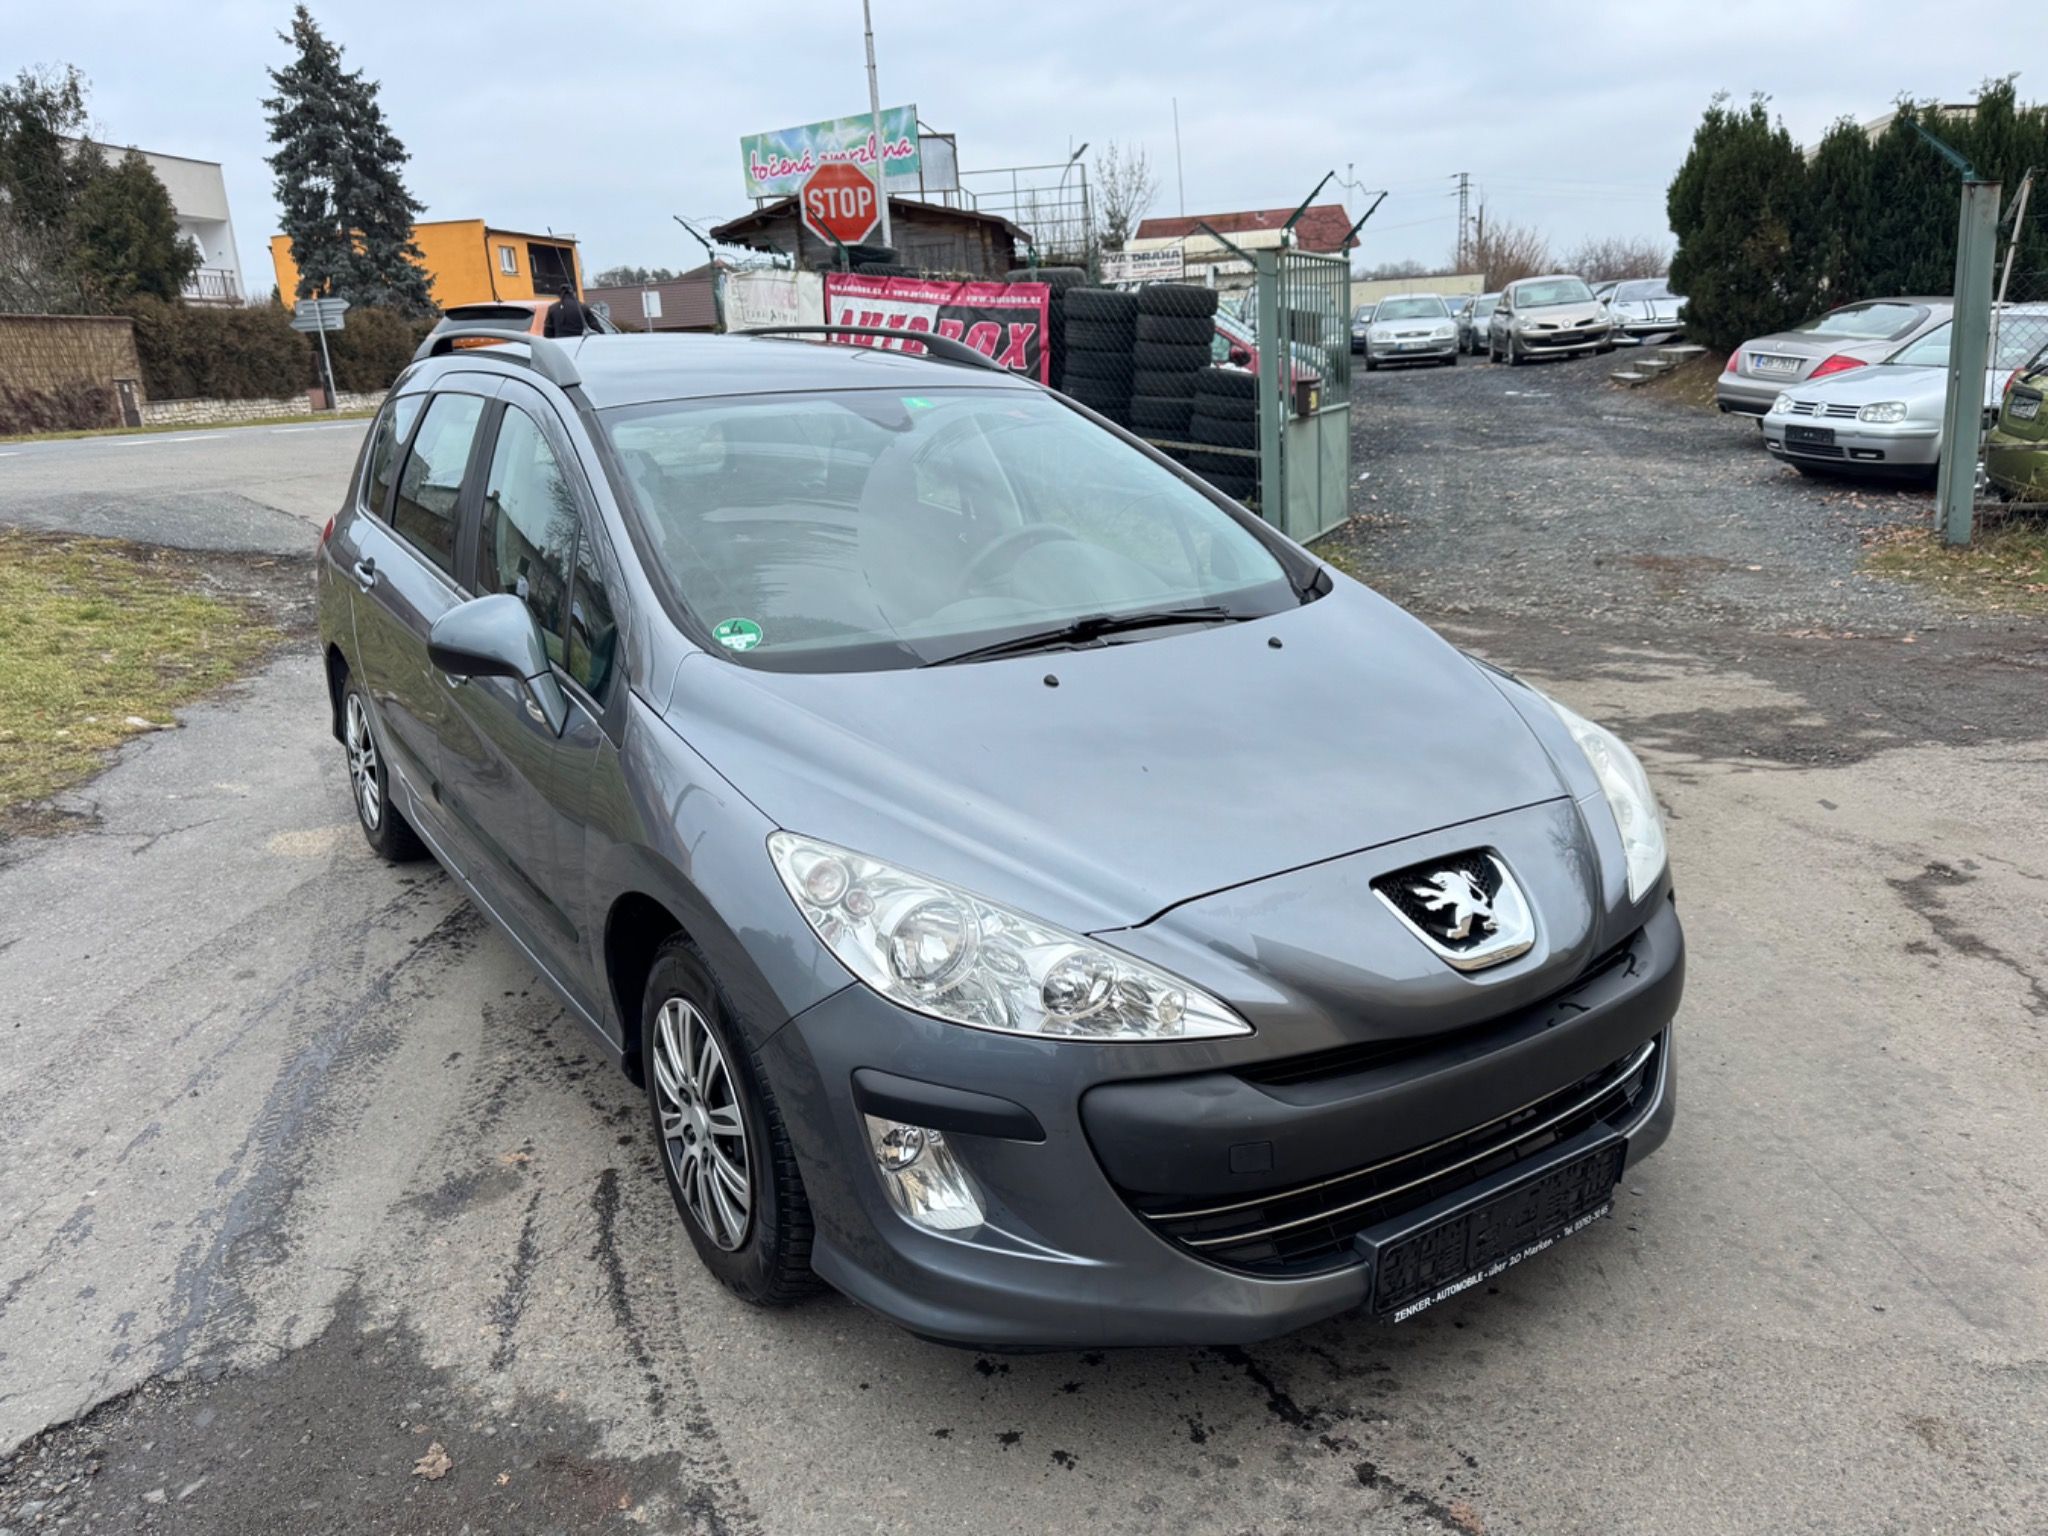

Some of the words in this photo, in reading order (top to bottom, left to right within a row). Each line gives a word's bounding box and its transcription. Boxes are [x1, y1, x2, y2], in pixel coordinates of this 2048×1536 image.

[751, 149, 815, 180] točená
[820, 136, 912, 162] mrzlna
[808, 186, 872, 219] STOP
[1523, 1238, 1554, 1259] Marken
